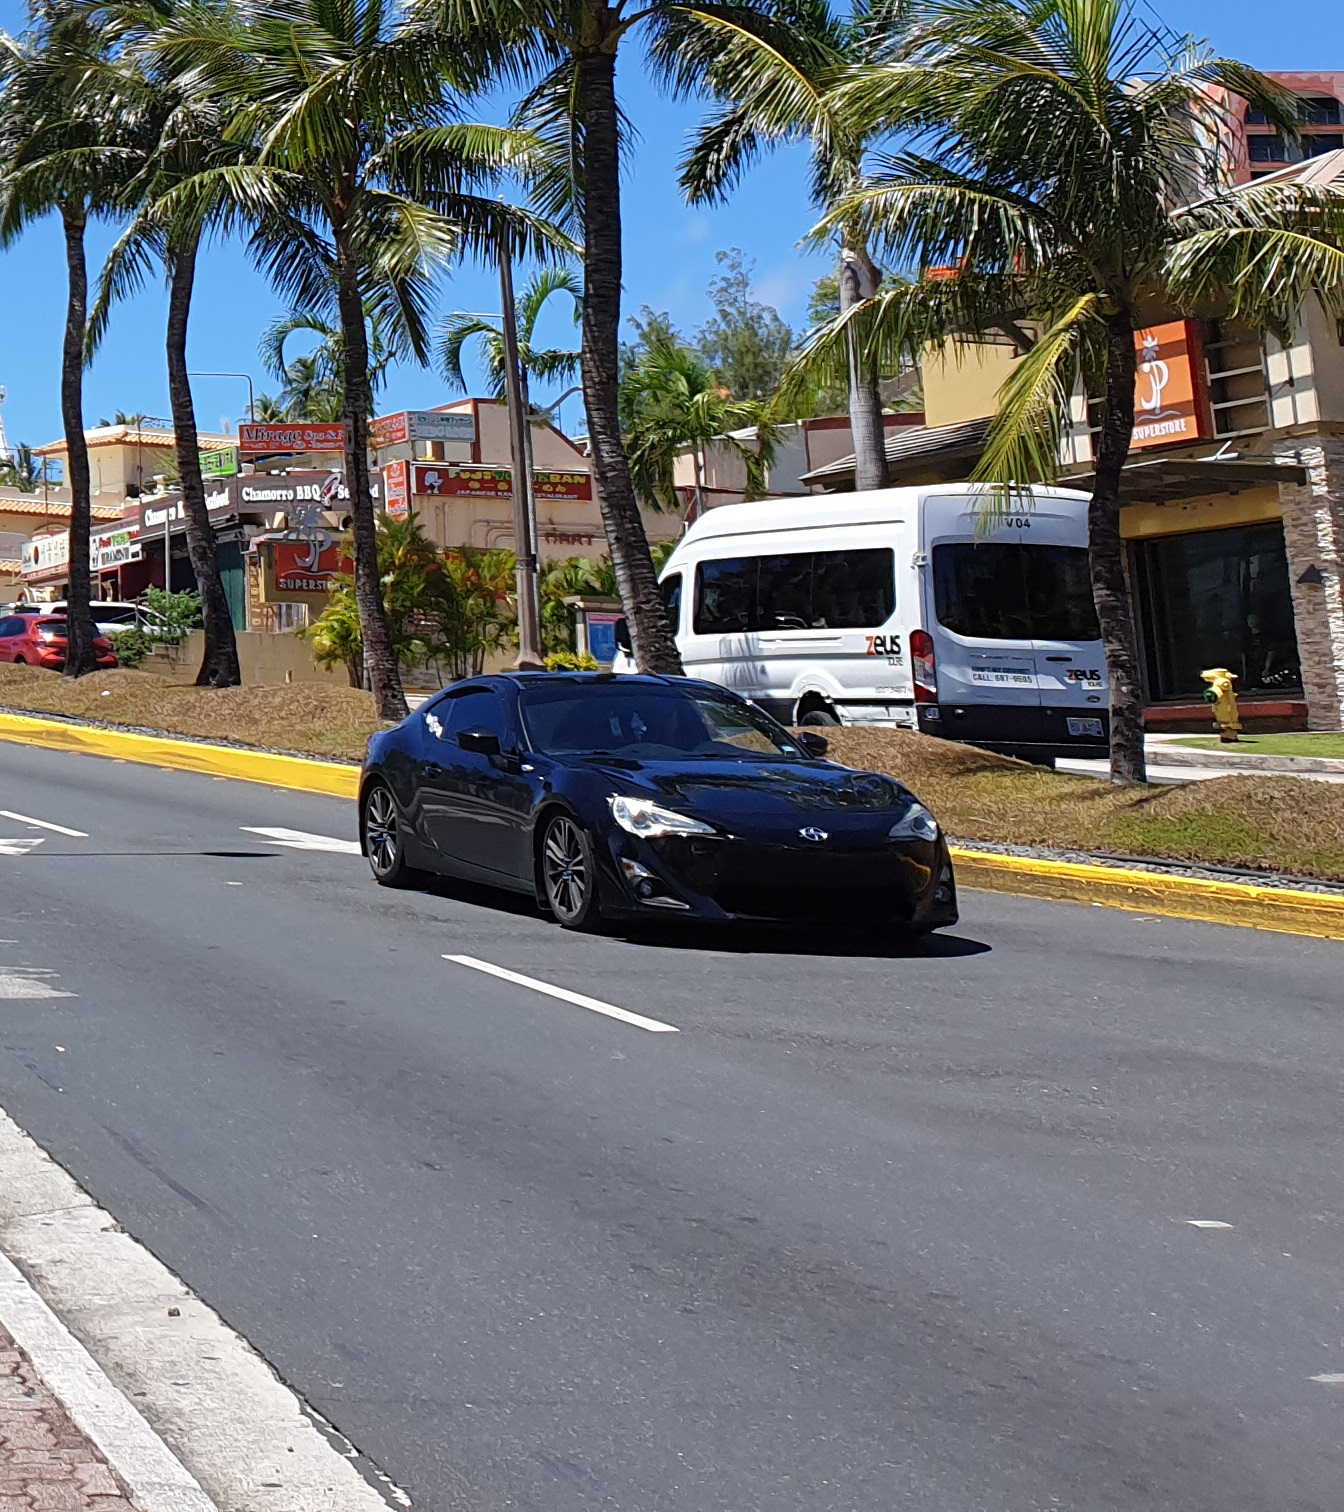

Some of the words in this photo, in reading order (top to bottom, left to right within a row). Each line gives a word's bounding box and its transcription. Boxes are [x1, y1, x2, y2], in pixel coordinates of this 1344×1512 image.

[243, 426, 301, 446] Mirage
[1132, 419, 1187, 440] SUPERSTORE
[241, 486, 294, 502] Chamorro
[296, 484, 321, 503] BBQ
[279, 578, 329, 590] SUPERST
[865, 635, 901, 656] zeus
[1066, 669, 1102, 681] zeus
